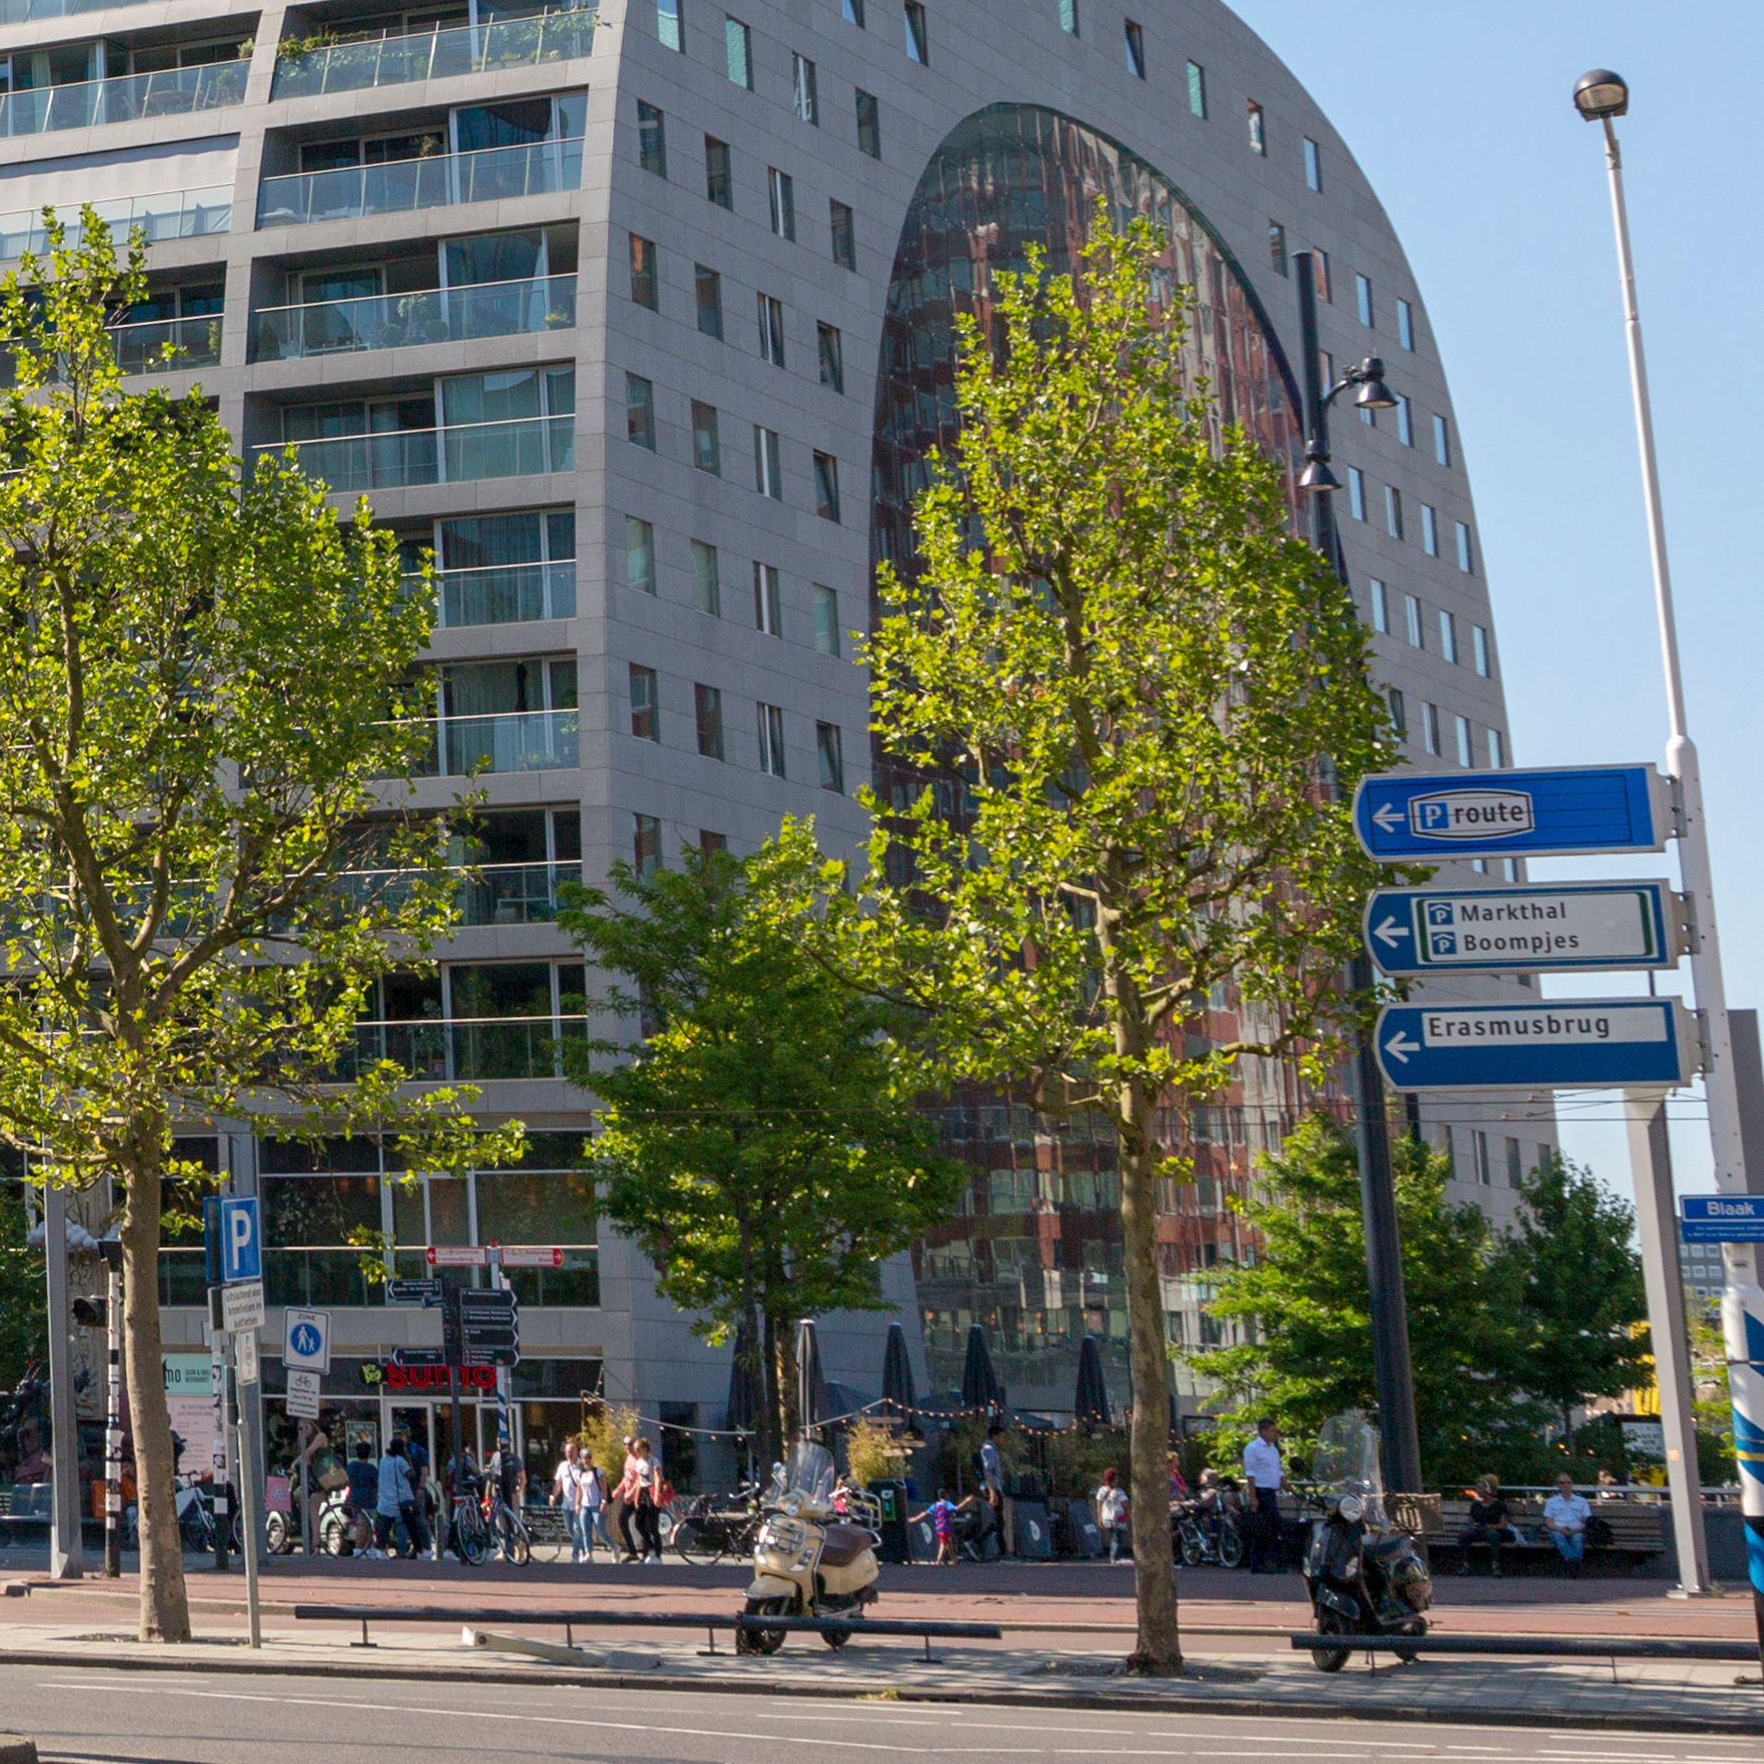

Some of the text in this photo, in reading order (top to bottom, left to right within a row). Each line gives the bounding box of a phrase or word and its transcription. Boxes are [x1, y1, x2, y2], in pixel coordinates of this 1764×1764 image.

[1454, 801, 1525, 824] route
[1461, 902, 1567, 922] Markthal
[1464, 931, 1579, 954] Boompjes
[1429, 1014, 1611, 1038] Erasmusbrug
[1706, 1200, 1756, 1216] Blaak
[230, 1209, 252, 1271] P
[297, 1312, 317, 1322] ZONE
